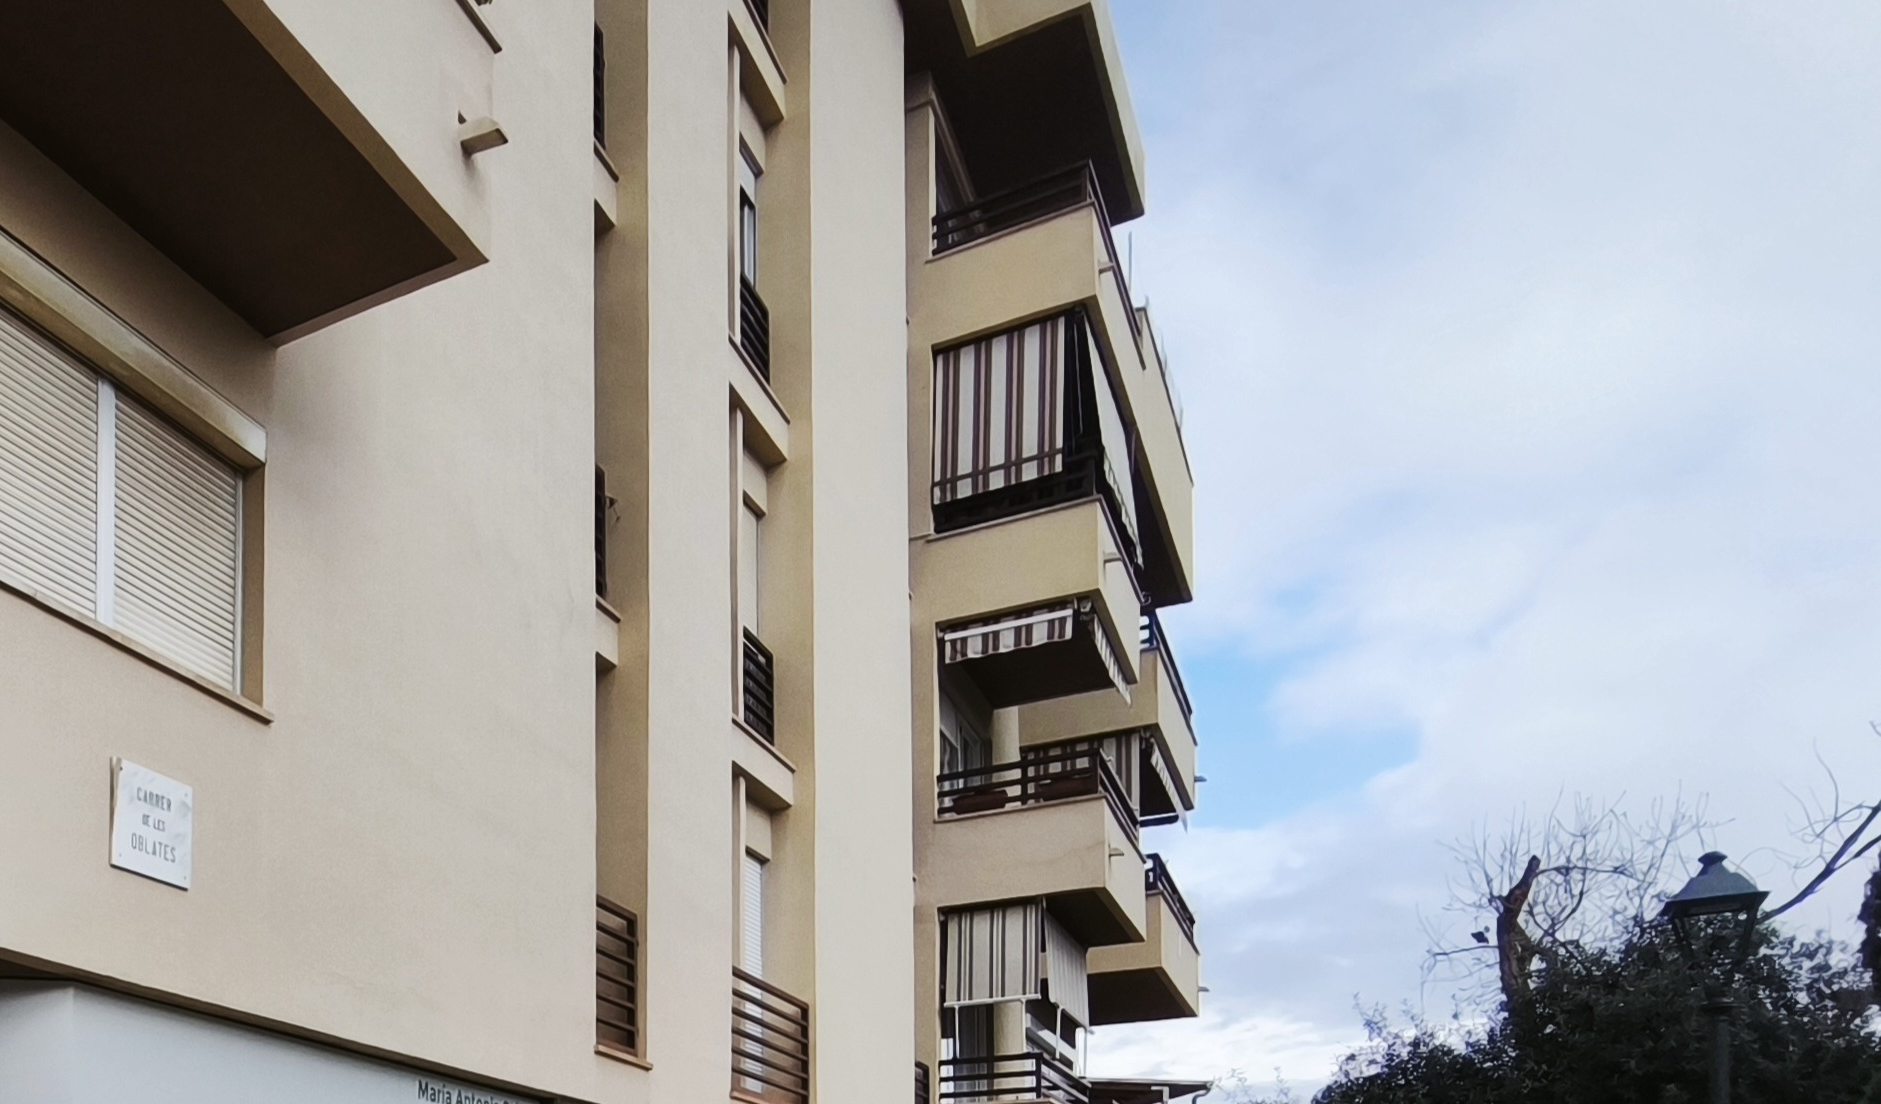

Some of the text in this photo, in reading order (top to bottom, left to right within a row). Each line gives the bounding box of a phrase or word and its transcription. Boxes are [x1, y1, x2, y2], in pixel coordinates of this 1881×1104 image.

[136, 786, 172, 813] CARRER
[142, 813, 166, 832] DE LES
[131, 832, 176, 863] OBLATES
